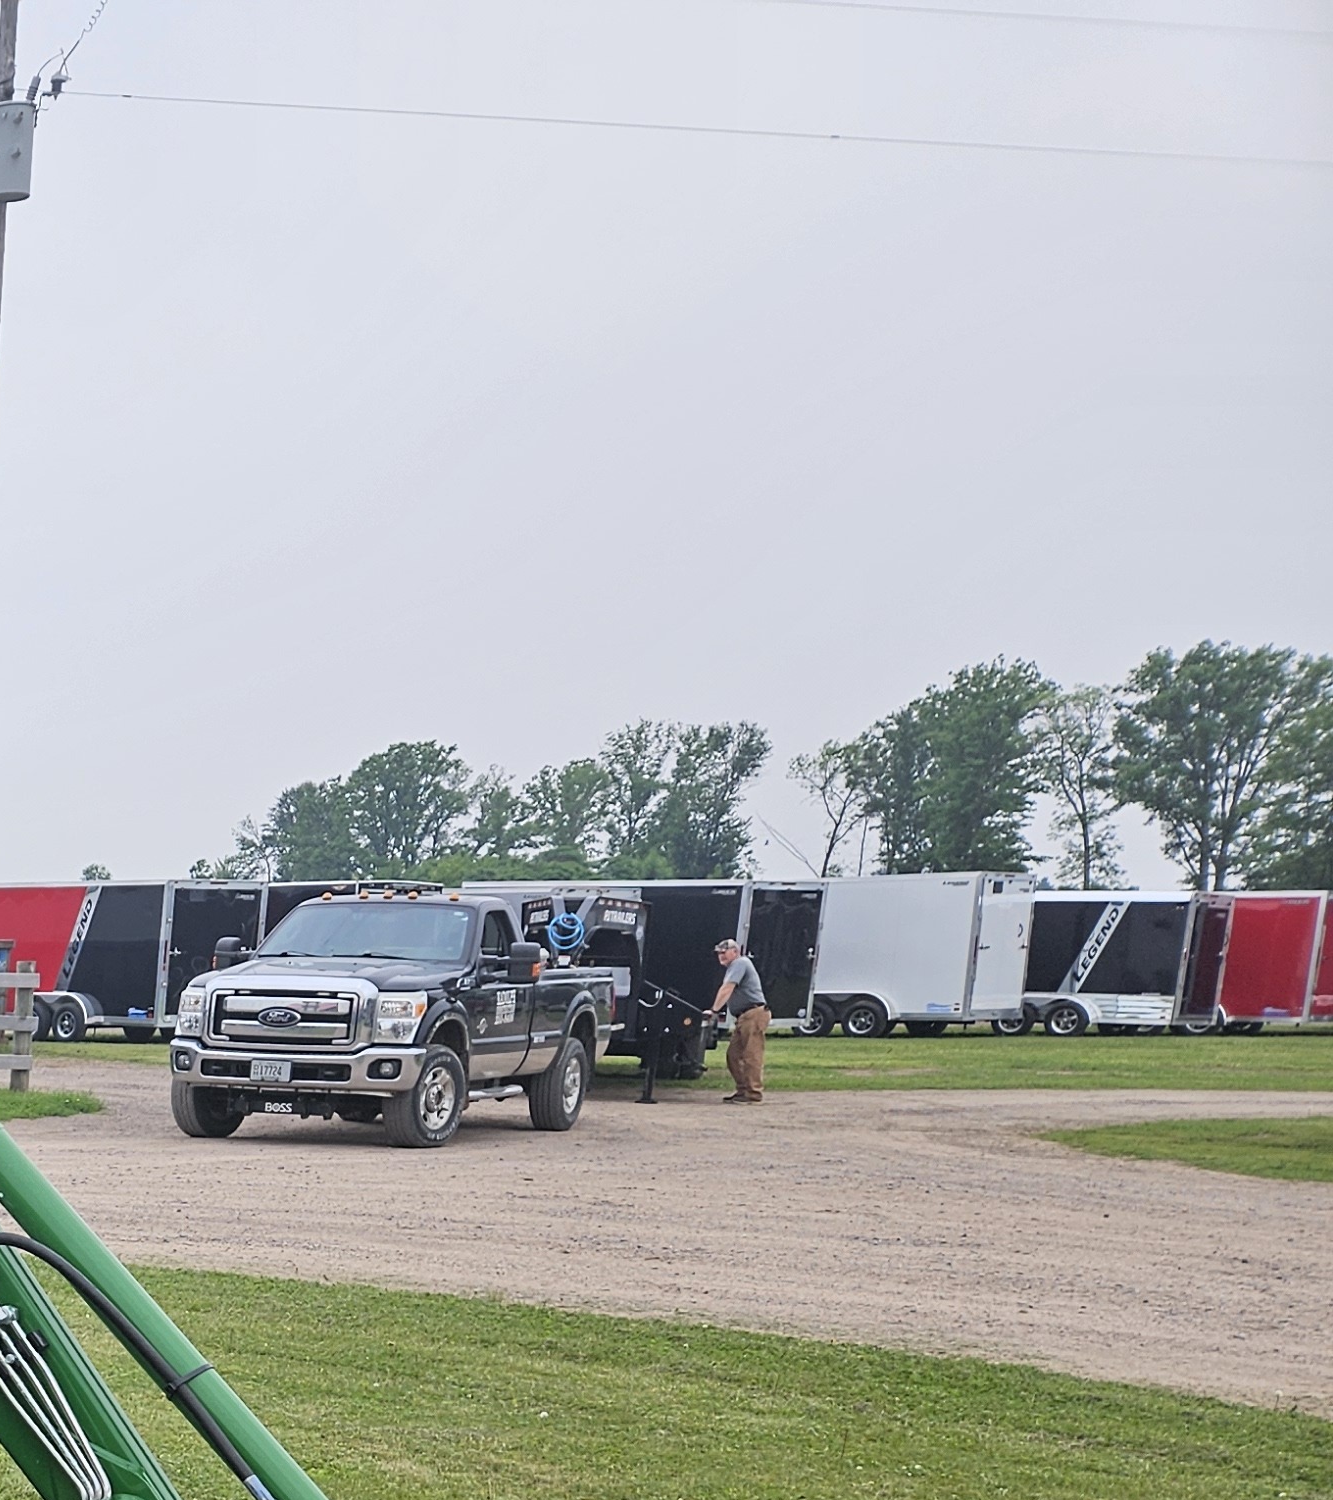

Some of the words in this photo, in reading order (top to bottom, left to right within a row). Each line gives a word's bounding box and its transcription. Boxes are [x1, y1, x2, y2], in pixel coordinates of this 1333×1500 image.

[62, 898, 93, 979] LEGEND
[1072, 907, 1119, 983] LEGEND
[266, 1009, 291, 1022] Ford
[264, 1102, 293, 1113] BOSS
